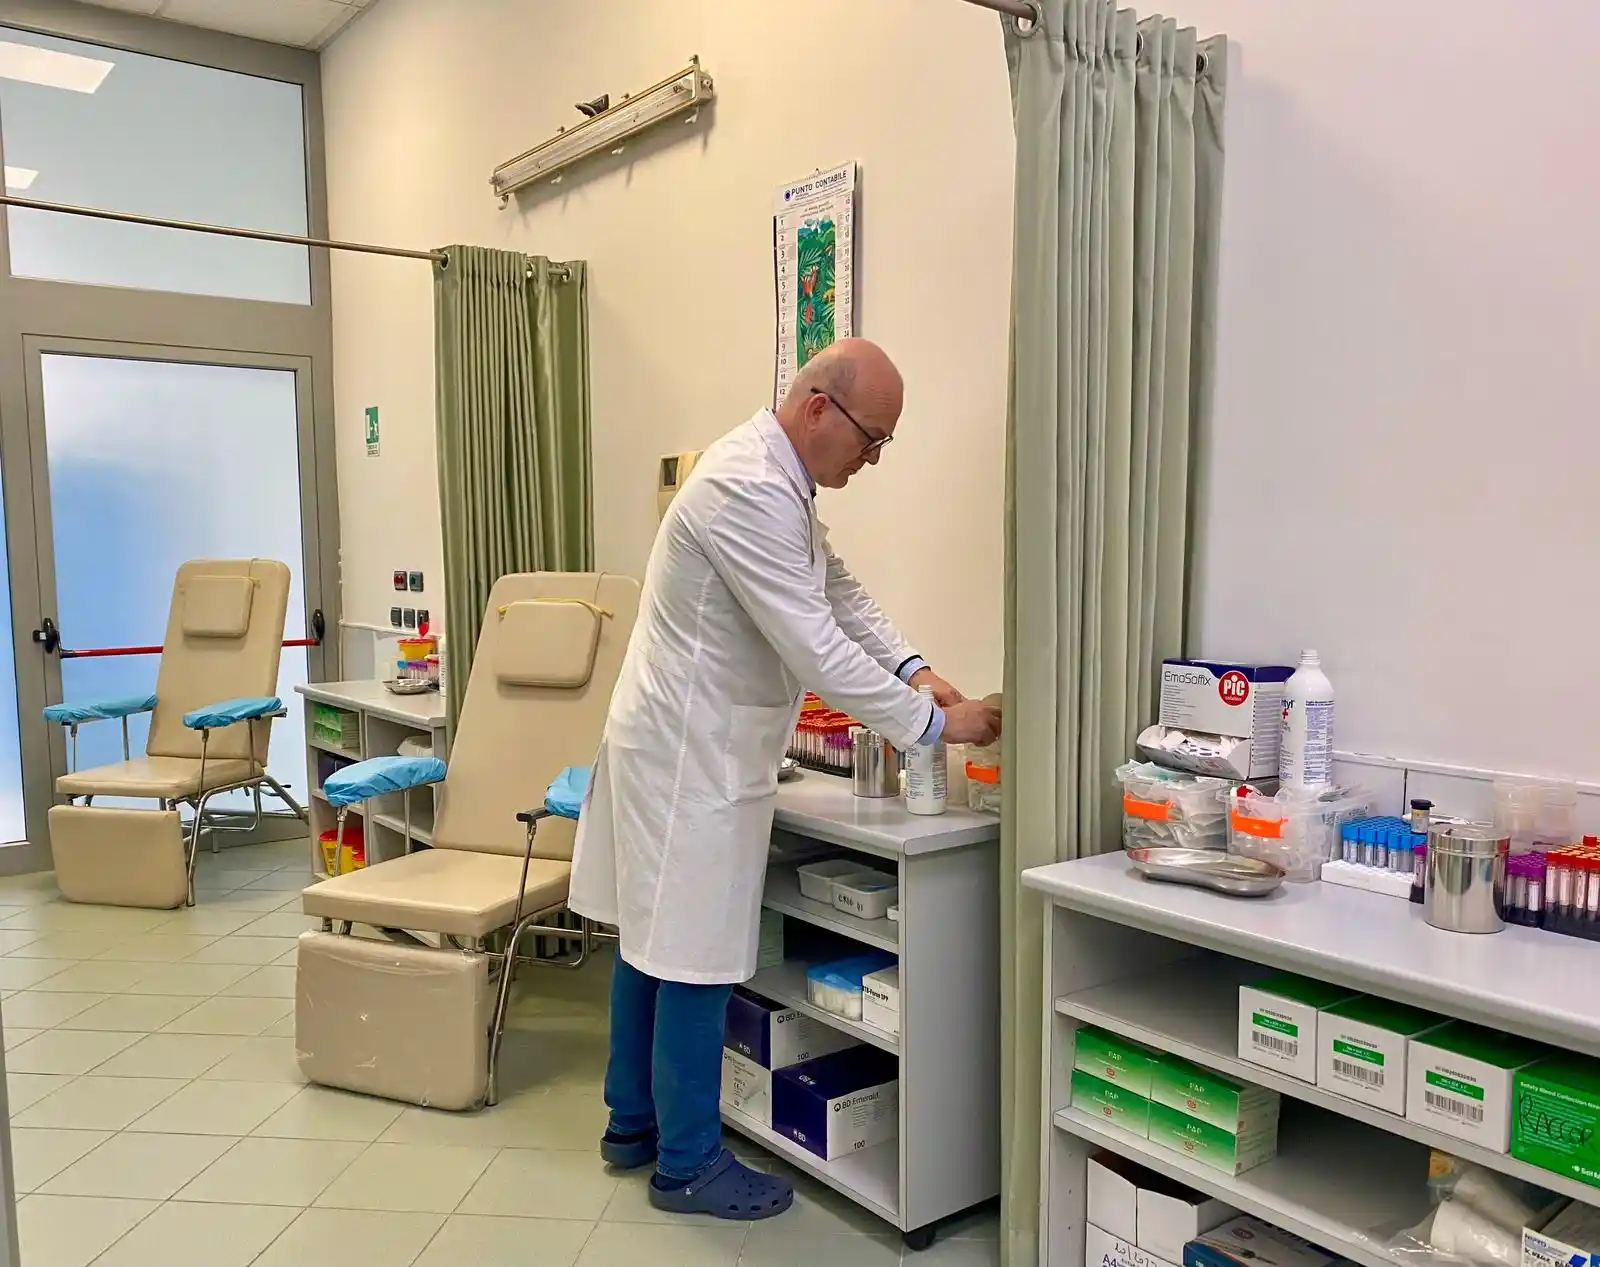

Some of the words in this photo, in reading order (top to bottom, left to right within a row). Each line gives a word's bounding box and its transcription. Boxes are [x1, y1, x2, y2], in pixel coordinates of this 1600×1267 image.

[792, 183, 813, 196] PUNTO
[815, 170, 847, 189] CONTABILE
[1163, 670, 1212, 686] EmoSoffix
[797, 1052, 810, 1060] 100
[841, 1099, 852, 1109] BD
[852, 1091, 880, 1106] Emerald
[1520, 1081, 1539, 1093] Safety
[1556, 1088, 1588, 1106] Collection
[797, 1131, 806, 1142] BD
[853, 1140, 866, 1150] 100
